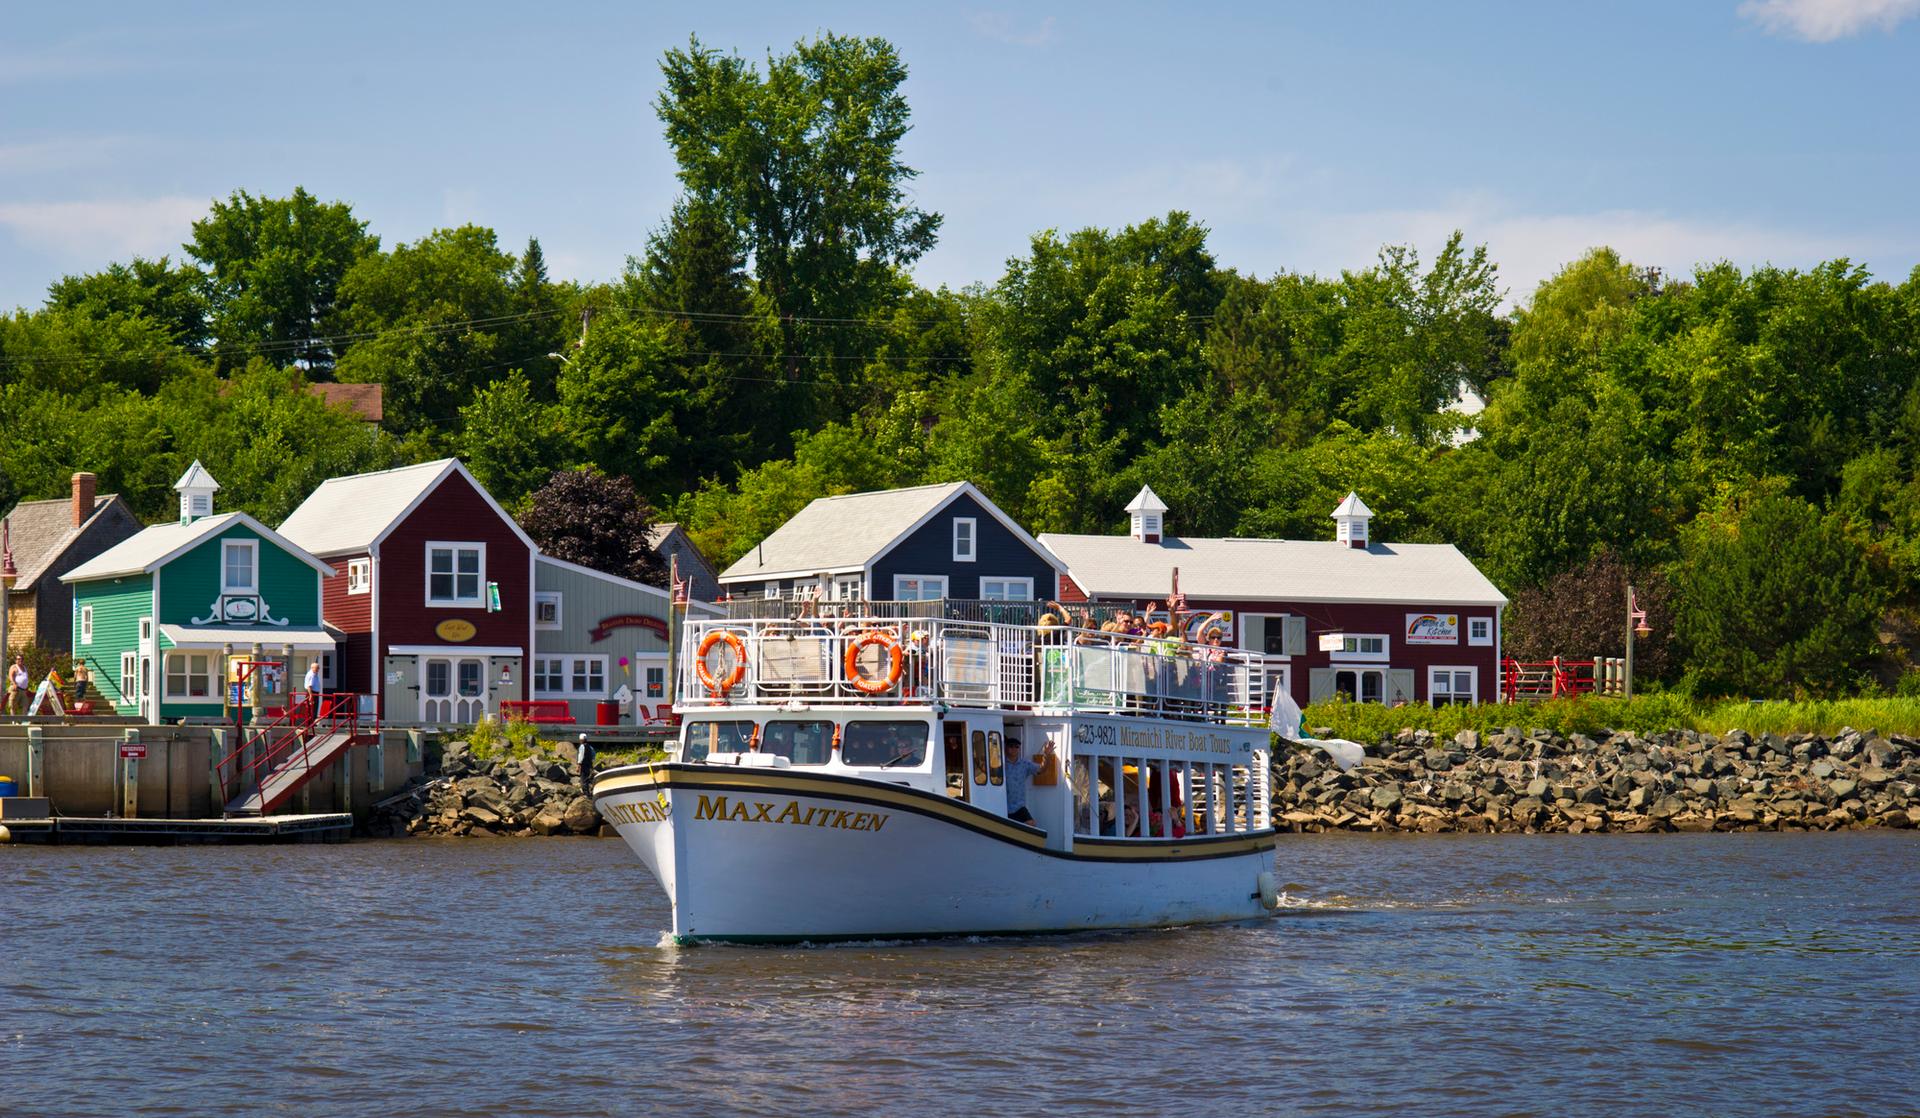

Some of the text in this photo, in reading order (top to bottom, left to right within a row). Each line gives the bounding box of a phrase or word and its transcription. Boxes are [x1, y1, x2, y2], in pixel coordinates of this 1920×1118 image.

[1078, 723, 1231, 754] 623-9821 Miramichi River Boat Tours
